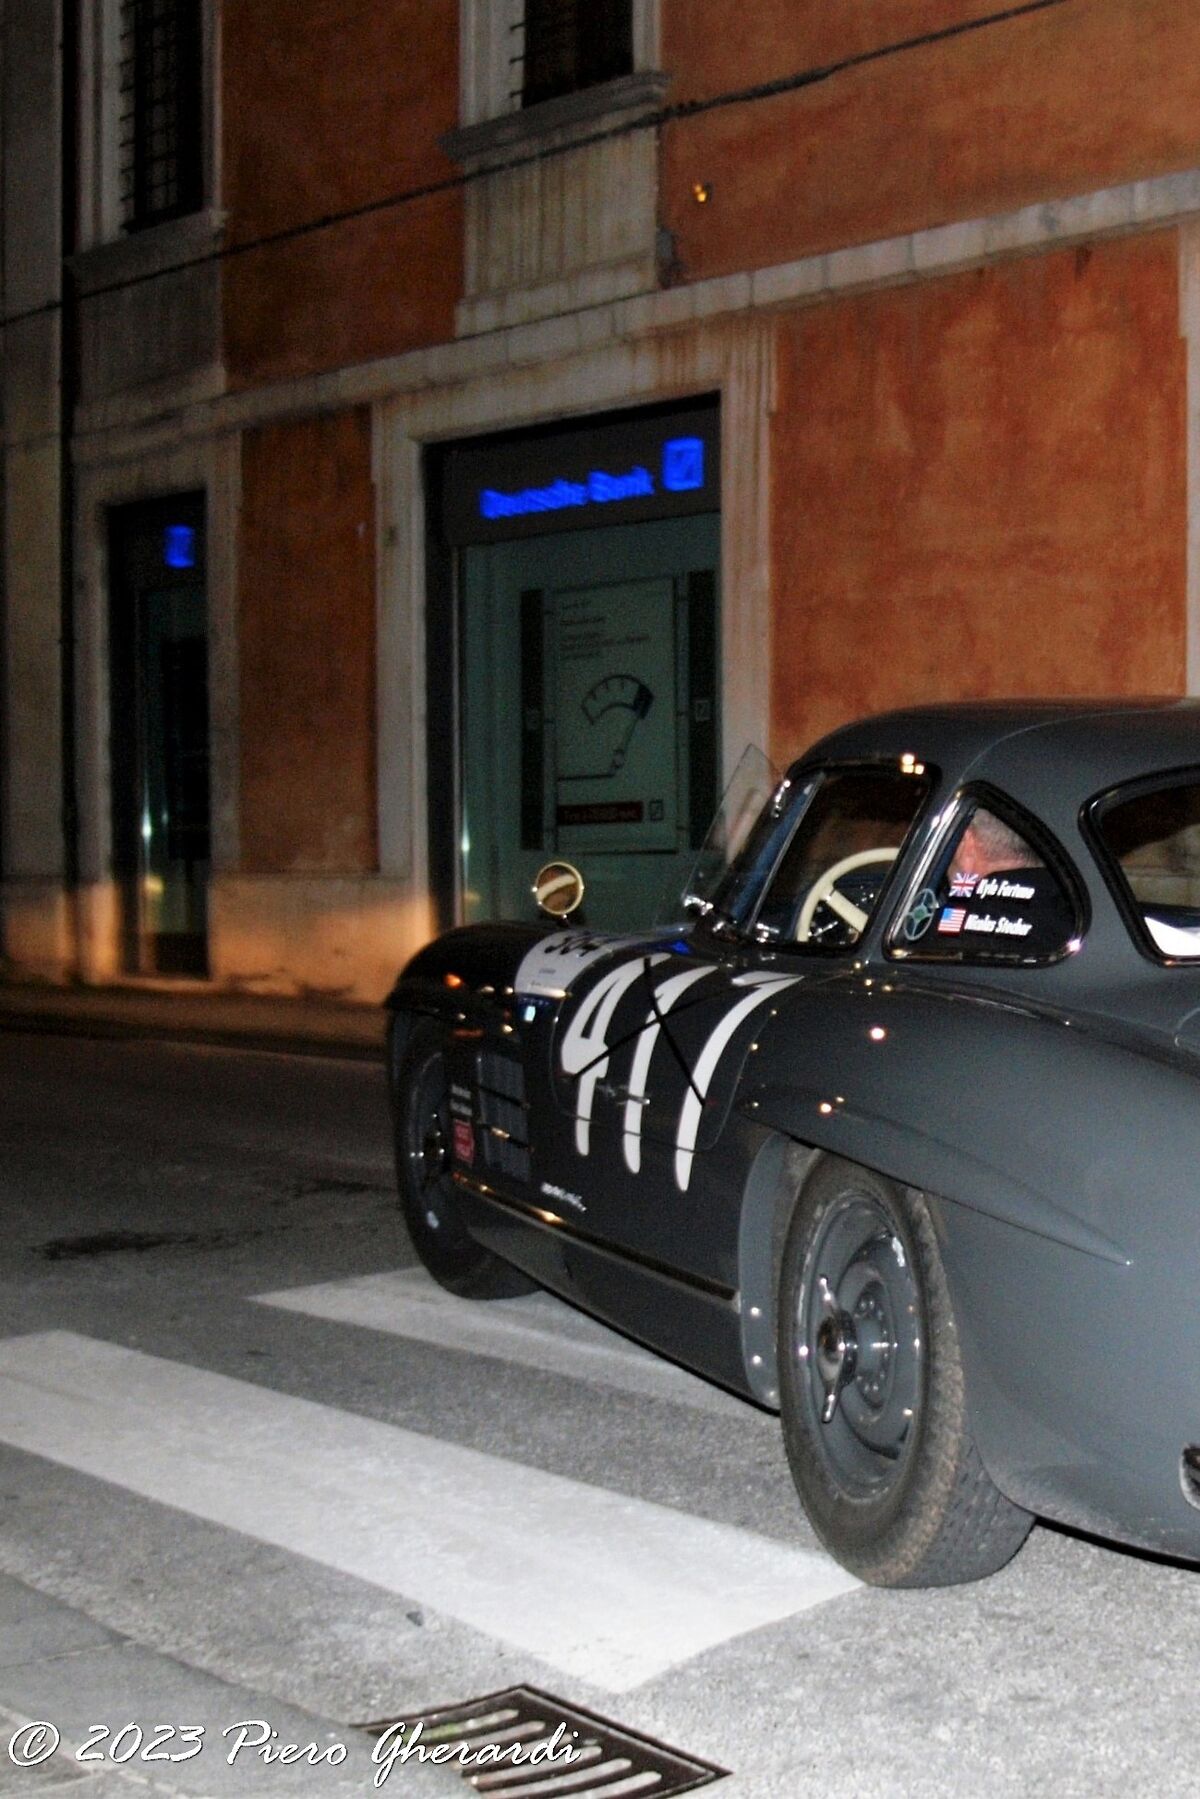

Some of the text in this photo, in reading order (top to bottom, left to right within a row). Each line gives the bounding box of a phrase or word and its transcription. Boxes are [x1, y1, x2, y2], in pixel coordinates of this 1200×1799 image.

[480, 465, 655, 519] Deutsche Bank
[561, 952, 806, 1192] 417
